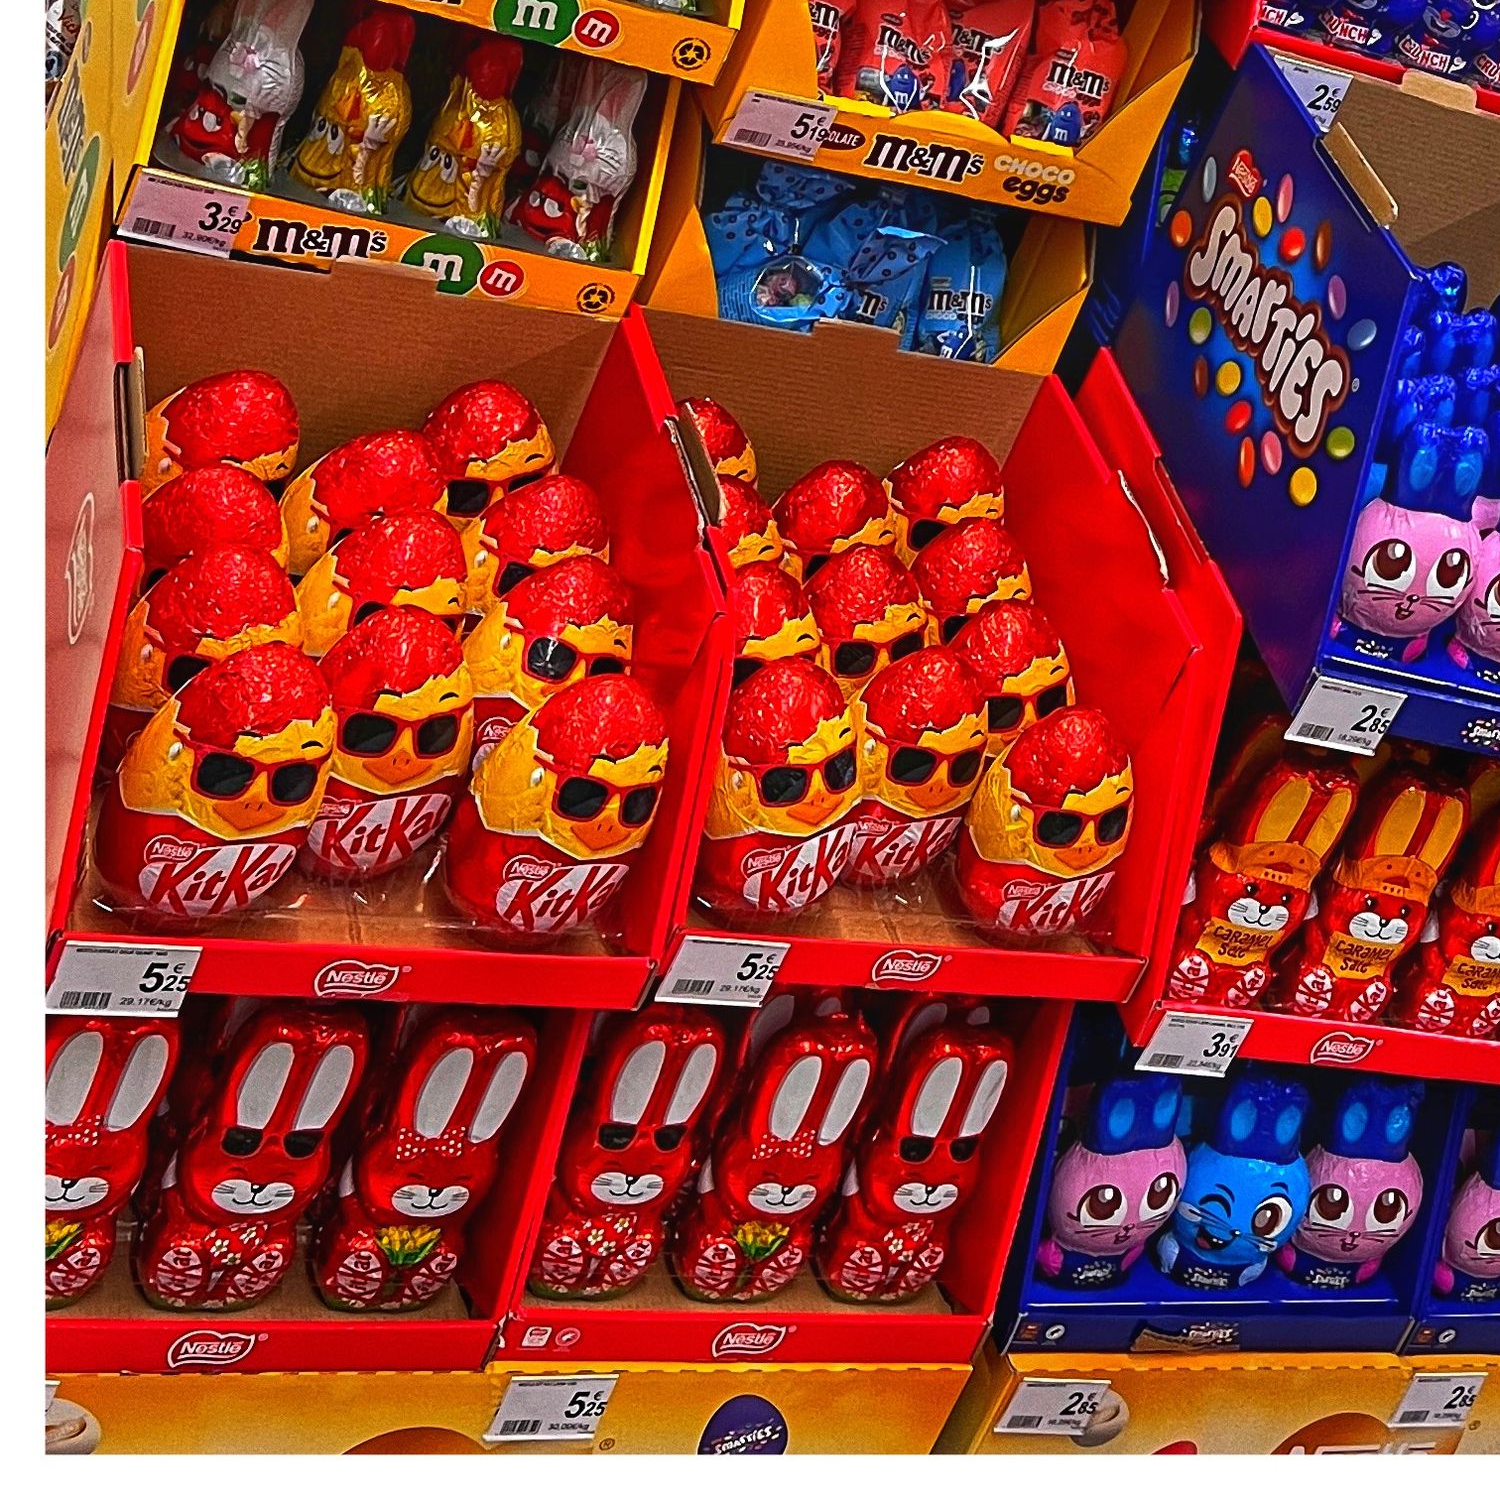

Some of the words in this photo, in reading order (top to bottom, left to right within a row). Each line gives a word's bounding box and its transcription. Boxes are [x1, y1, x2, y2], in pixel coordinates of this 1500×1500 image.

[581, 15, 614, 44] m
[993, 154, 1075, 183] CHOCO
[1002, 174, 1070, 203] eggs
[488, 264, 515, 292] m
[757, 826, 848, 910] KitKa
[506, 866, 625, 928] KitKa
